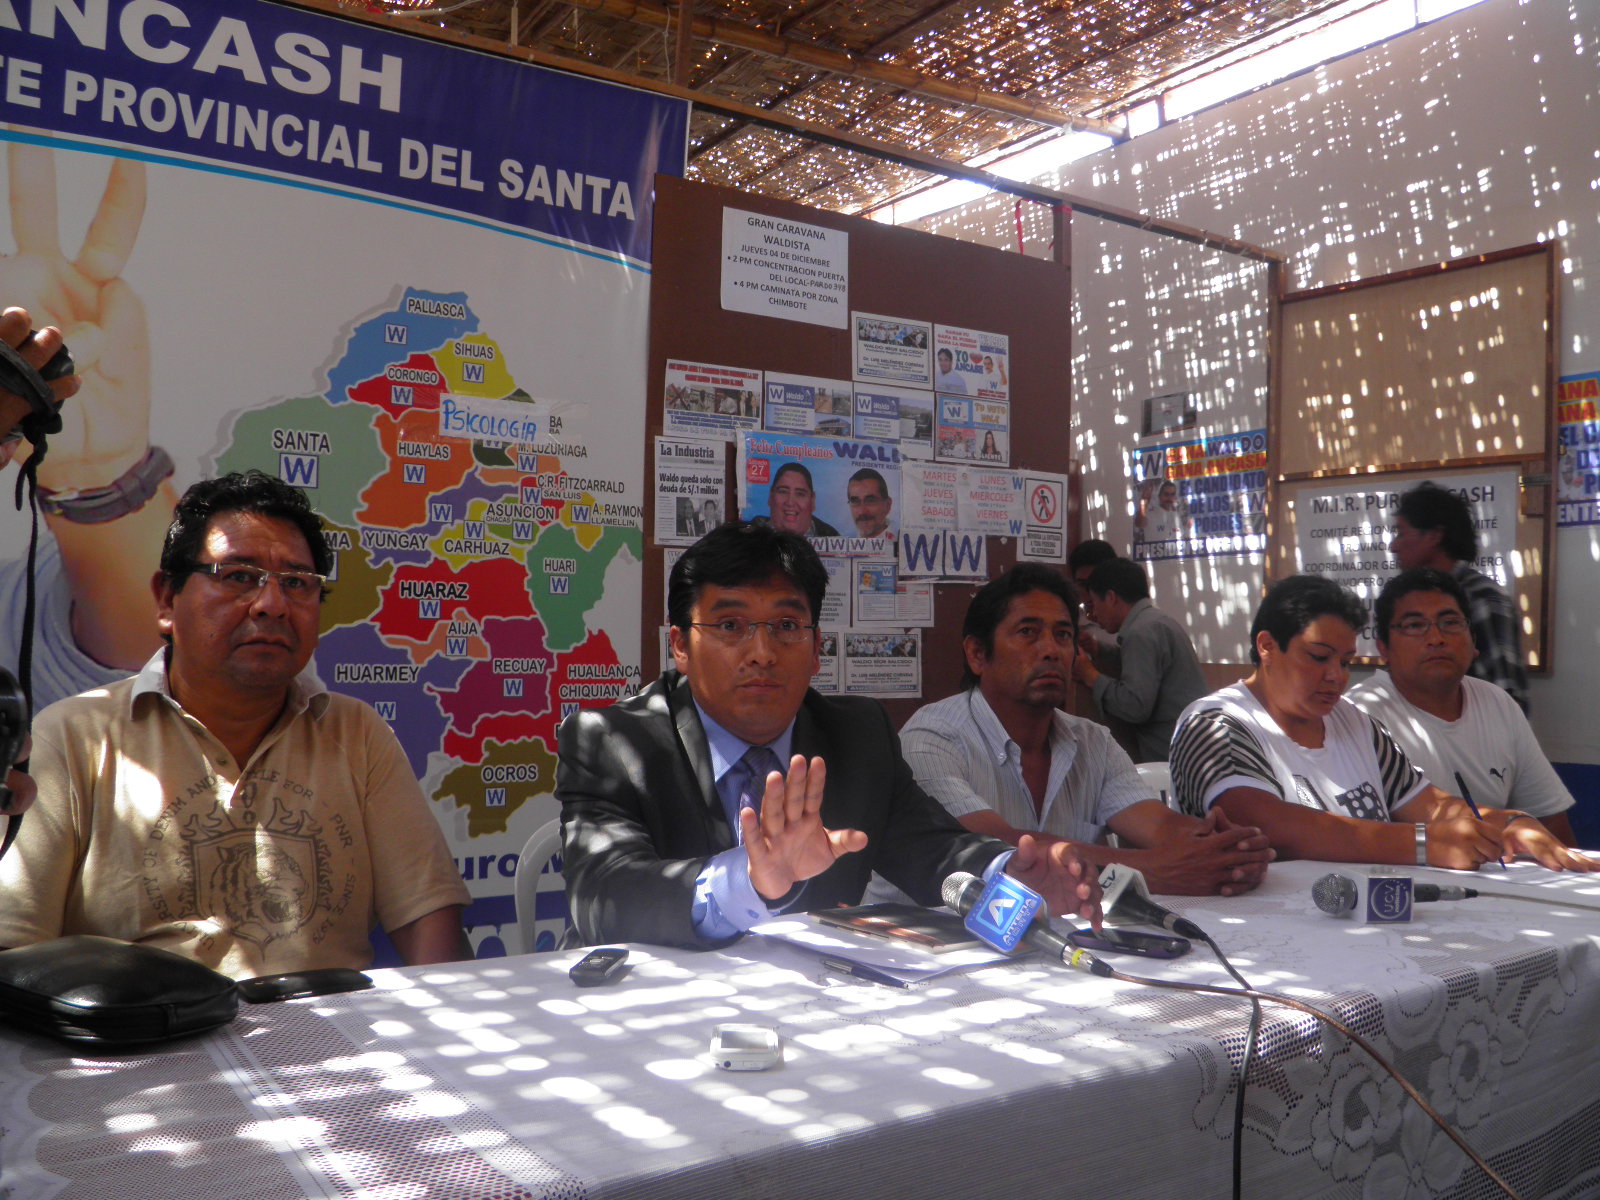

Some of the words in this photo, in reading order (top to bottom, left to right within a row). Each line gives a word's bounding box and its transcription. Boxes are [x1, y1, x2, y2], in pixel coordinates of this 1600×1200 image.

[0, 55, 42, 109] E
[63, 69, 383, 174] PROVINCIAL
[400, 138, 485, 192] DEL
[499, 158, 635, 222] SANTA
[747, 217, 774, 230] GRAN
[776, 222, 826, 241] CARAVANA
[763, 235, 811, 252] WALDISTA
[741, 244, 768, 256] JUEVES
[780, 251, 791, 260] DE
[792, 254, 831, 268] DICIEMBRE
[732, 255, 739, 263] 2
[739, 256, 752, 265] PM
[753, 259, 816, 277] CONCENTRACION
[818, 270, 845, 283] PUERTA
[769, 273, 784, 284] DEL
[746, 281, 759, 291] PM
[760, 285, 800, 298] CAMINATA
[802, 291, 817, 301] POR
[818, 294, 839, 305] ZONA
[407, 298, 465, 318] PALLASCA
[768, 297, 808, 310] CHIMBOTE
[387, 326, 406, 343] W
[454, 343, 494, 359] SIHUAS
[387, 367, 438, 384] CORONGO
[465, 365, 483, 381] W
[393, 388, 412, 404] W
[769, 387, 783, 400] W
[1558, 379, 1599, 402] ANA
[858, 398, 871, 410] W
[1558, 401, 1596, 422] ANA
[273, 429, 331, 453] SANTA
[398, 442, 449, 459] HUAYLAS
[660, 444, 672, 456] La
[674, 444, 715, 459] Industria
[750, 439, 773, 456] Feliz
[775, 440, 834, 461] Cumpleaños
[283, 456, 315, 484] W
[519, 455, 536, 472] W
[752, 464, 765, 476] 27
[405, 465, 424, 482] W
[659, 472, 680, 483] Waldo
[681, 474, 698, 487] queda
[700, 476, 712, 485] solo
[923, 470, 957, 483] MARTES
[980, 474, 1008, 486] LUNES
[537, 475, 556, 488] C.R.
[559, 476, 625, 494] FITZCARRALD
[659, 483, 678, 493] deuda
[679, 486, 687, 494] de
[1012, 476, 1023, 490] W
[524, 488, 541, 504] W
[543, 490, 561, 499] SAN
[563, 491, 582, 500] LUIS
[923, 487, 954, 499] JUEVES
[592, 504, 602, 517] A.
[1208, 494, 1230, 512] LOS
[1313, 497, 1360, 514] M.I.R.
[1366, 492, 1400, 511] PUR
[433, 504, 451, 521] W
[486, 504, 555, 520] ASUNCION
[573, 505, 590, 521] W
[921, 505, 956, 518] SABADO
[976, 509, 1009, 520] VIERNES
[591, 517, 635, 527] LLAMELLIN
[1009, 519, 1022, 535] W
[465, 522, 484, 539] W
[514, 525, 532, 539] W
[1310, 525, 1348, 539] COMITÉ
[1351, 524, 1398, 537] REGIONA
[325, 533, 349, 549] MA
[366, 532, 428, 550] YUNGAY
[444, 539, 510, 556] CARHUAZ
[831, 539, 846, 551] W
[851, 539, 866, 551] W
[871, 539, 885, 551] W
[1339, 541, 1394, 554] PROVINCIA
[903, 533, 940, 572] W
[949, 534, 983, 573] W
[544, 558, 575, 573] HUARI
[1304, 560, 1379, 573] COORDINADOR
[399, 582, 468, 600] HUARAZ
[551, 577, 568, 593] W
[421, 600, 439, 617] W
[448, 621, 478, 635] AIJA
[448, 638, 467, 655] W
[336, 664, 419, 682] HUARMEY
[493, 659, 546, 673] RECUAY
[568, 665, 641, 678] HUALLANCA
[505, 679, 522, 695] W
[560, 685, 620, 698] CHIQUIAN
[376, 703, 395, 719] W
[482, 765, 537, 782] OCROS
[487, 789, 505, 805] W
[455, 853, 520, 881] uro
